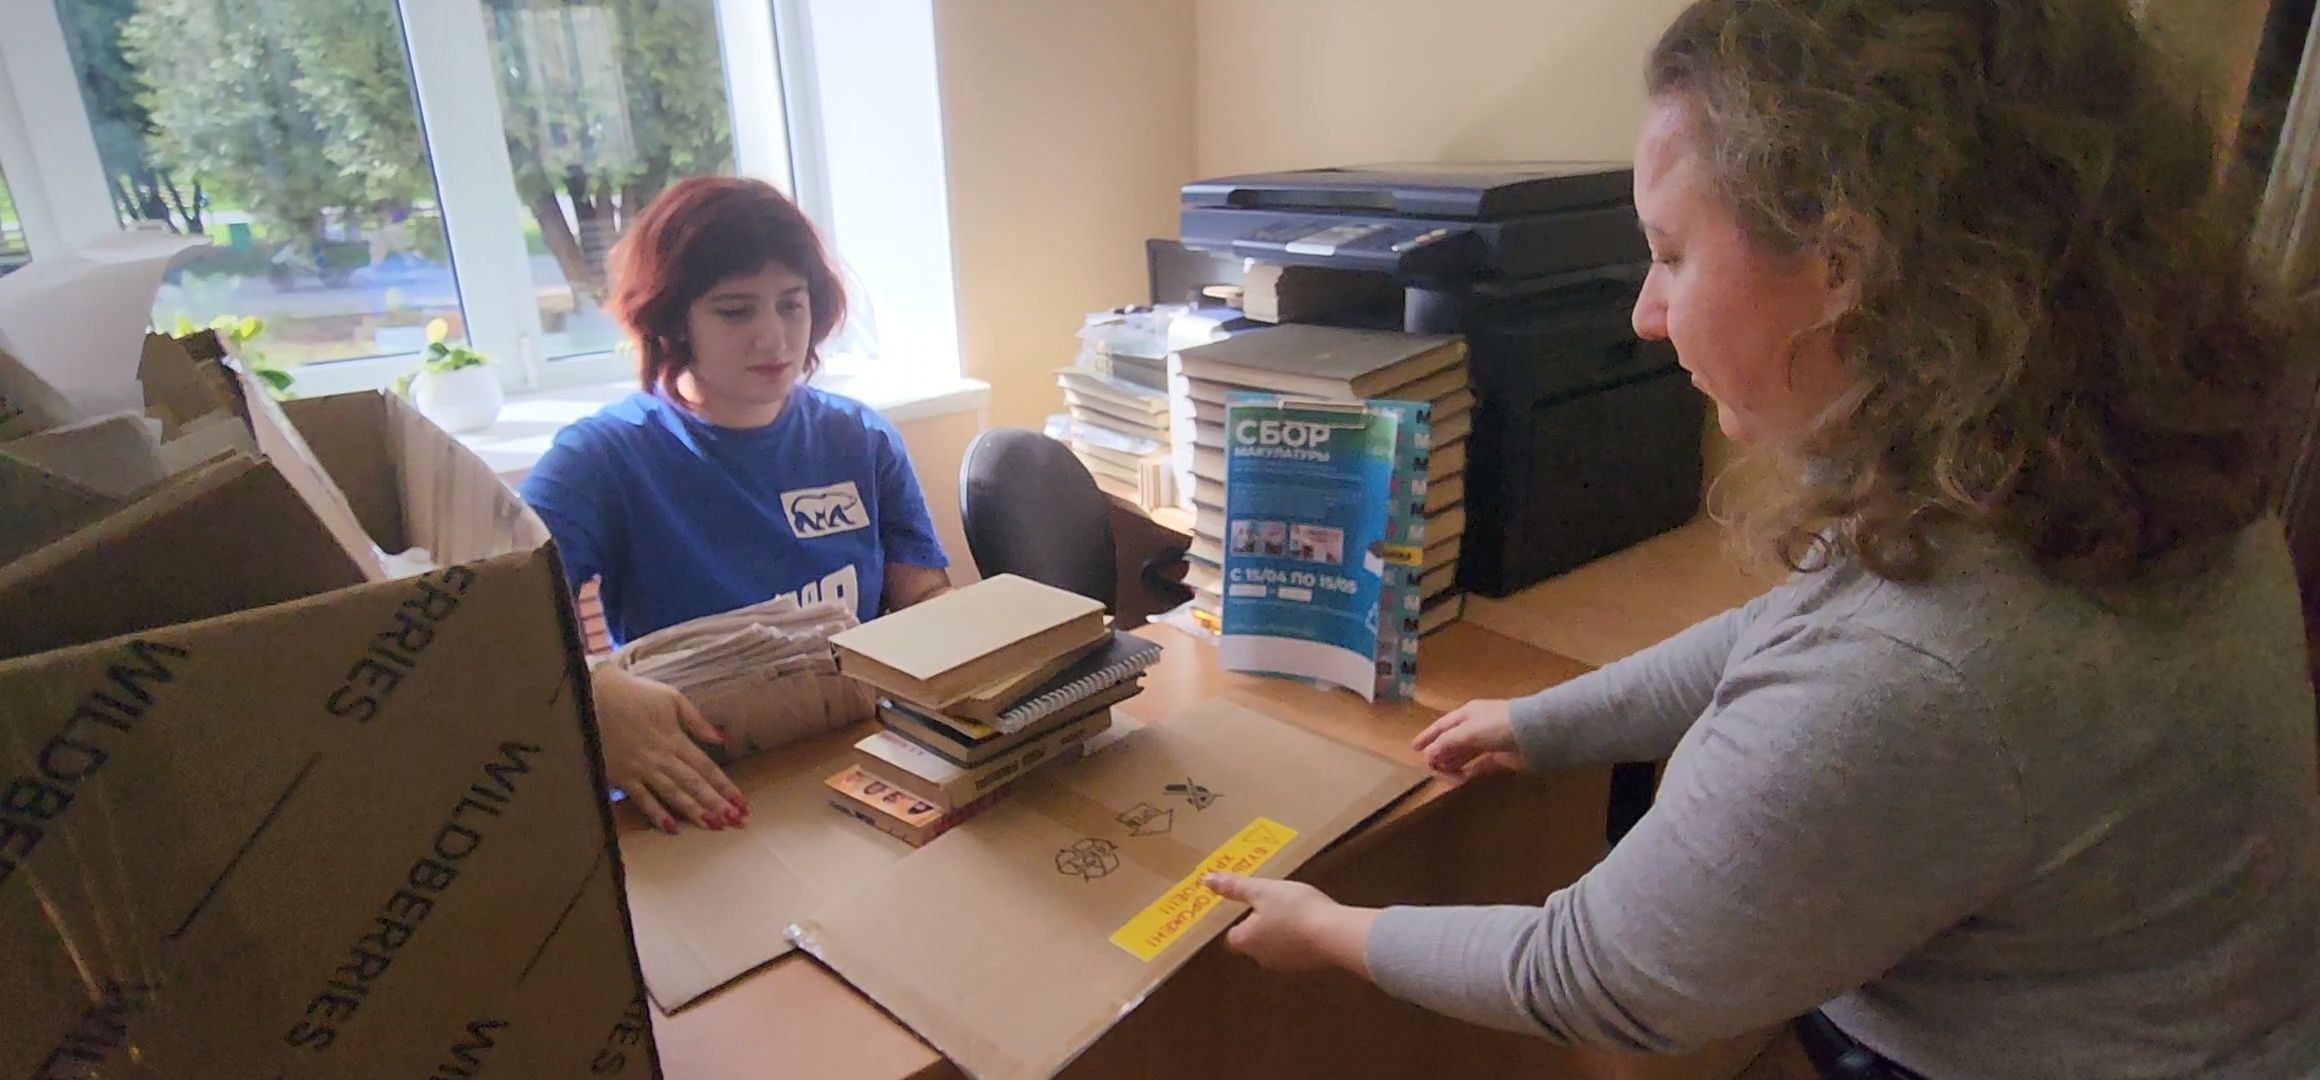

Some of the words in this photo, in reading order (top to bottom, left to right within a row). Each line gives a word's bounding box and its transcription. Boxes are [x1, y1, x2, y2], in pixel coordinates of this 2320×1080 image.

[1235, 420, 1331, 448] СБОР
[1290, 571, 1316, 588] ПО
[0, 639, 190, 883] WILDBE
[285, 740, 543, 1053] WILDBERRIES
